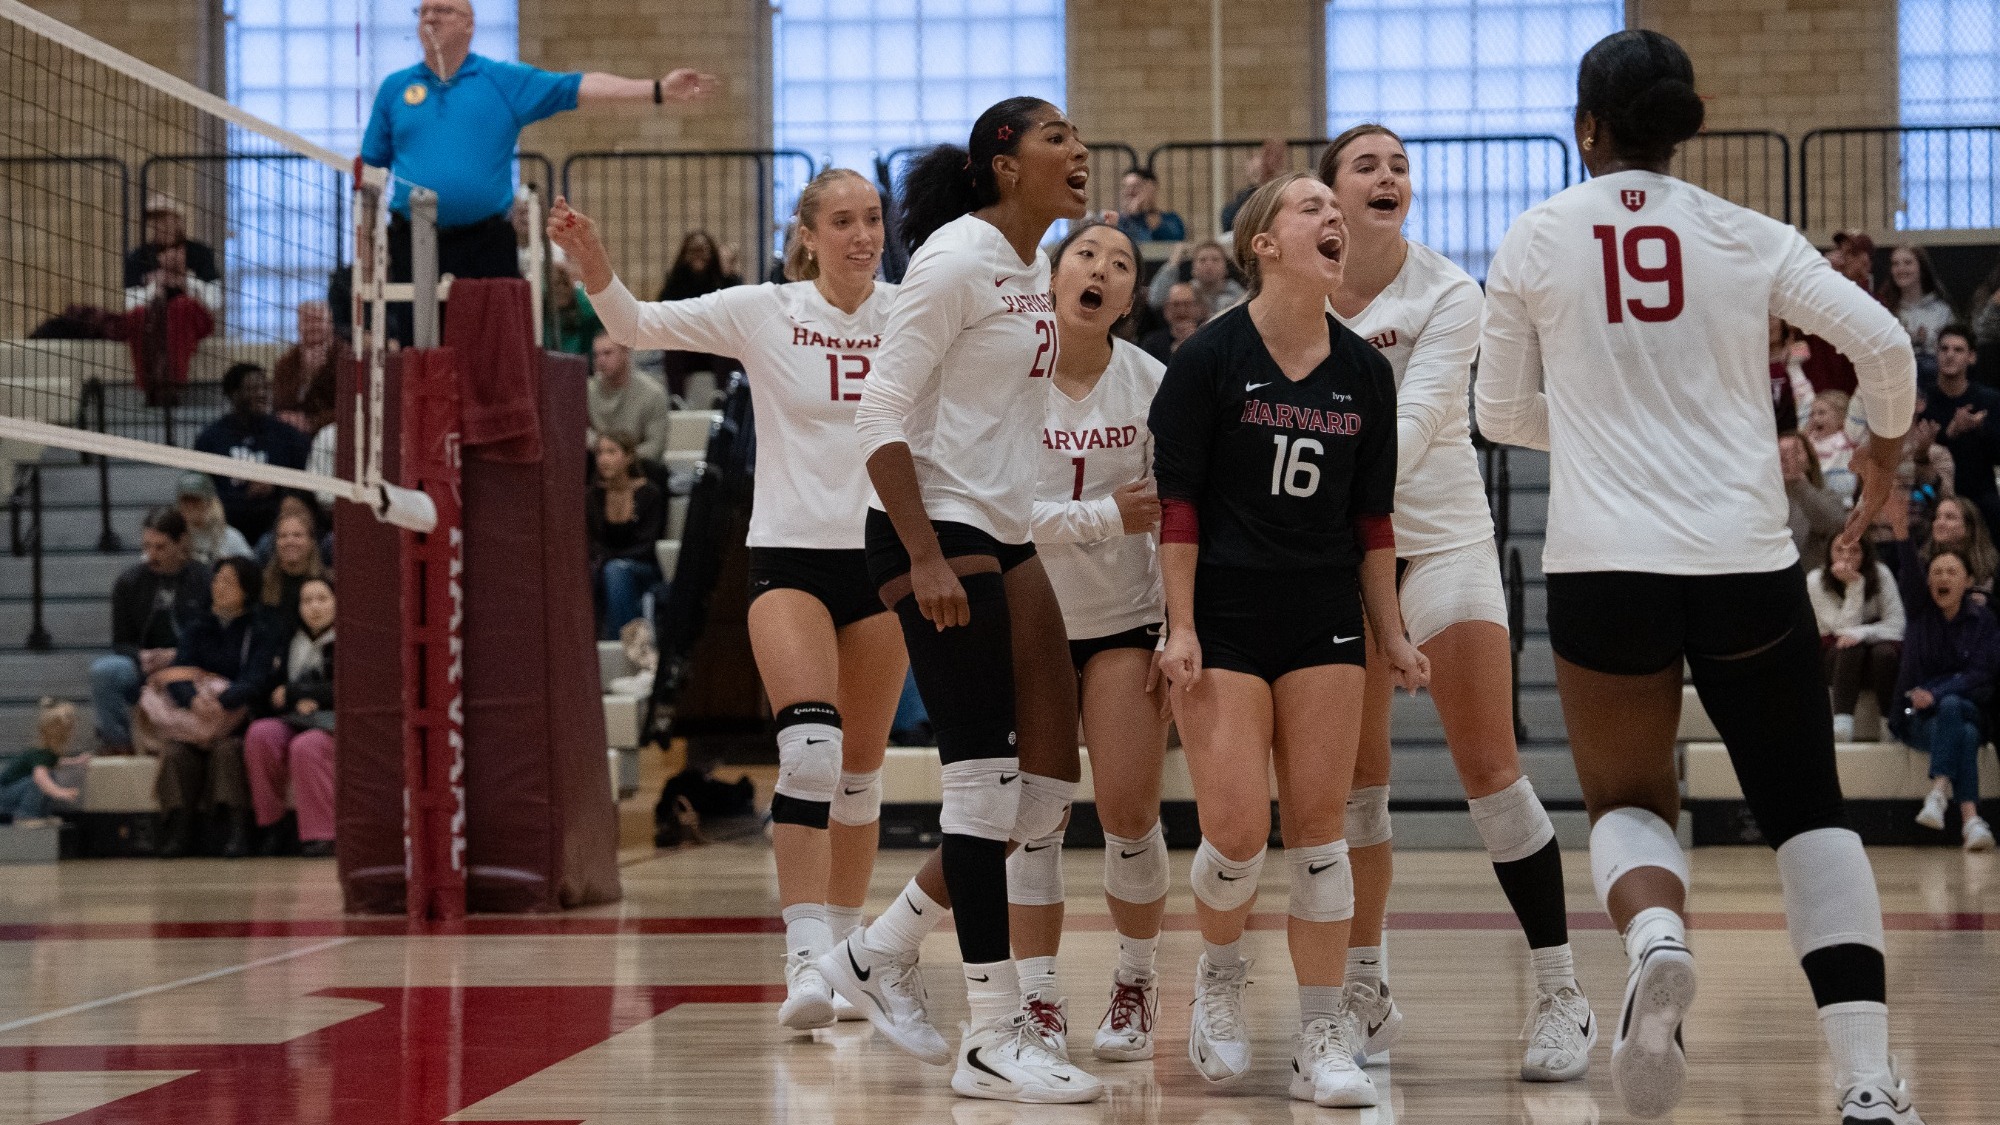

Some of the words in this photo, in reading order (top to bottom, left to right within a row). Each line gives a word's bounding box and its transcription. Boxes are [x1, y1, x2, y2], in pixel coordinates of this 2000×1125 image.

[1625, 191, 1641, 206] H
[1593, 225, 1684, 323] 19
[1029, 320, 1057, 378] 21
[826, 354, 870, 401] 13
[1241, 399, 1361, 435] HARVARD
[1072, 457, 1085, 501] 1
[1271, 434, 1324, 497] 16
[1027, 992, 1039, 1000] NIKE
[1014, 1014, 1026, 1025] NIKE
